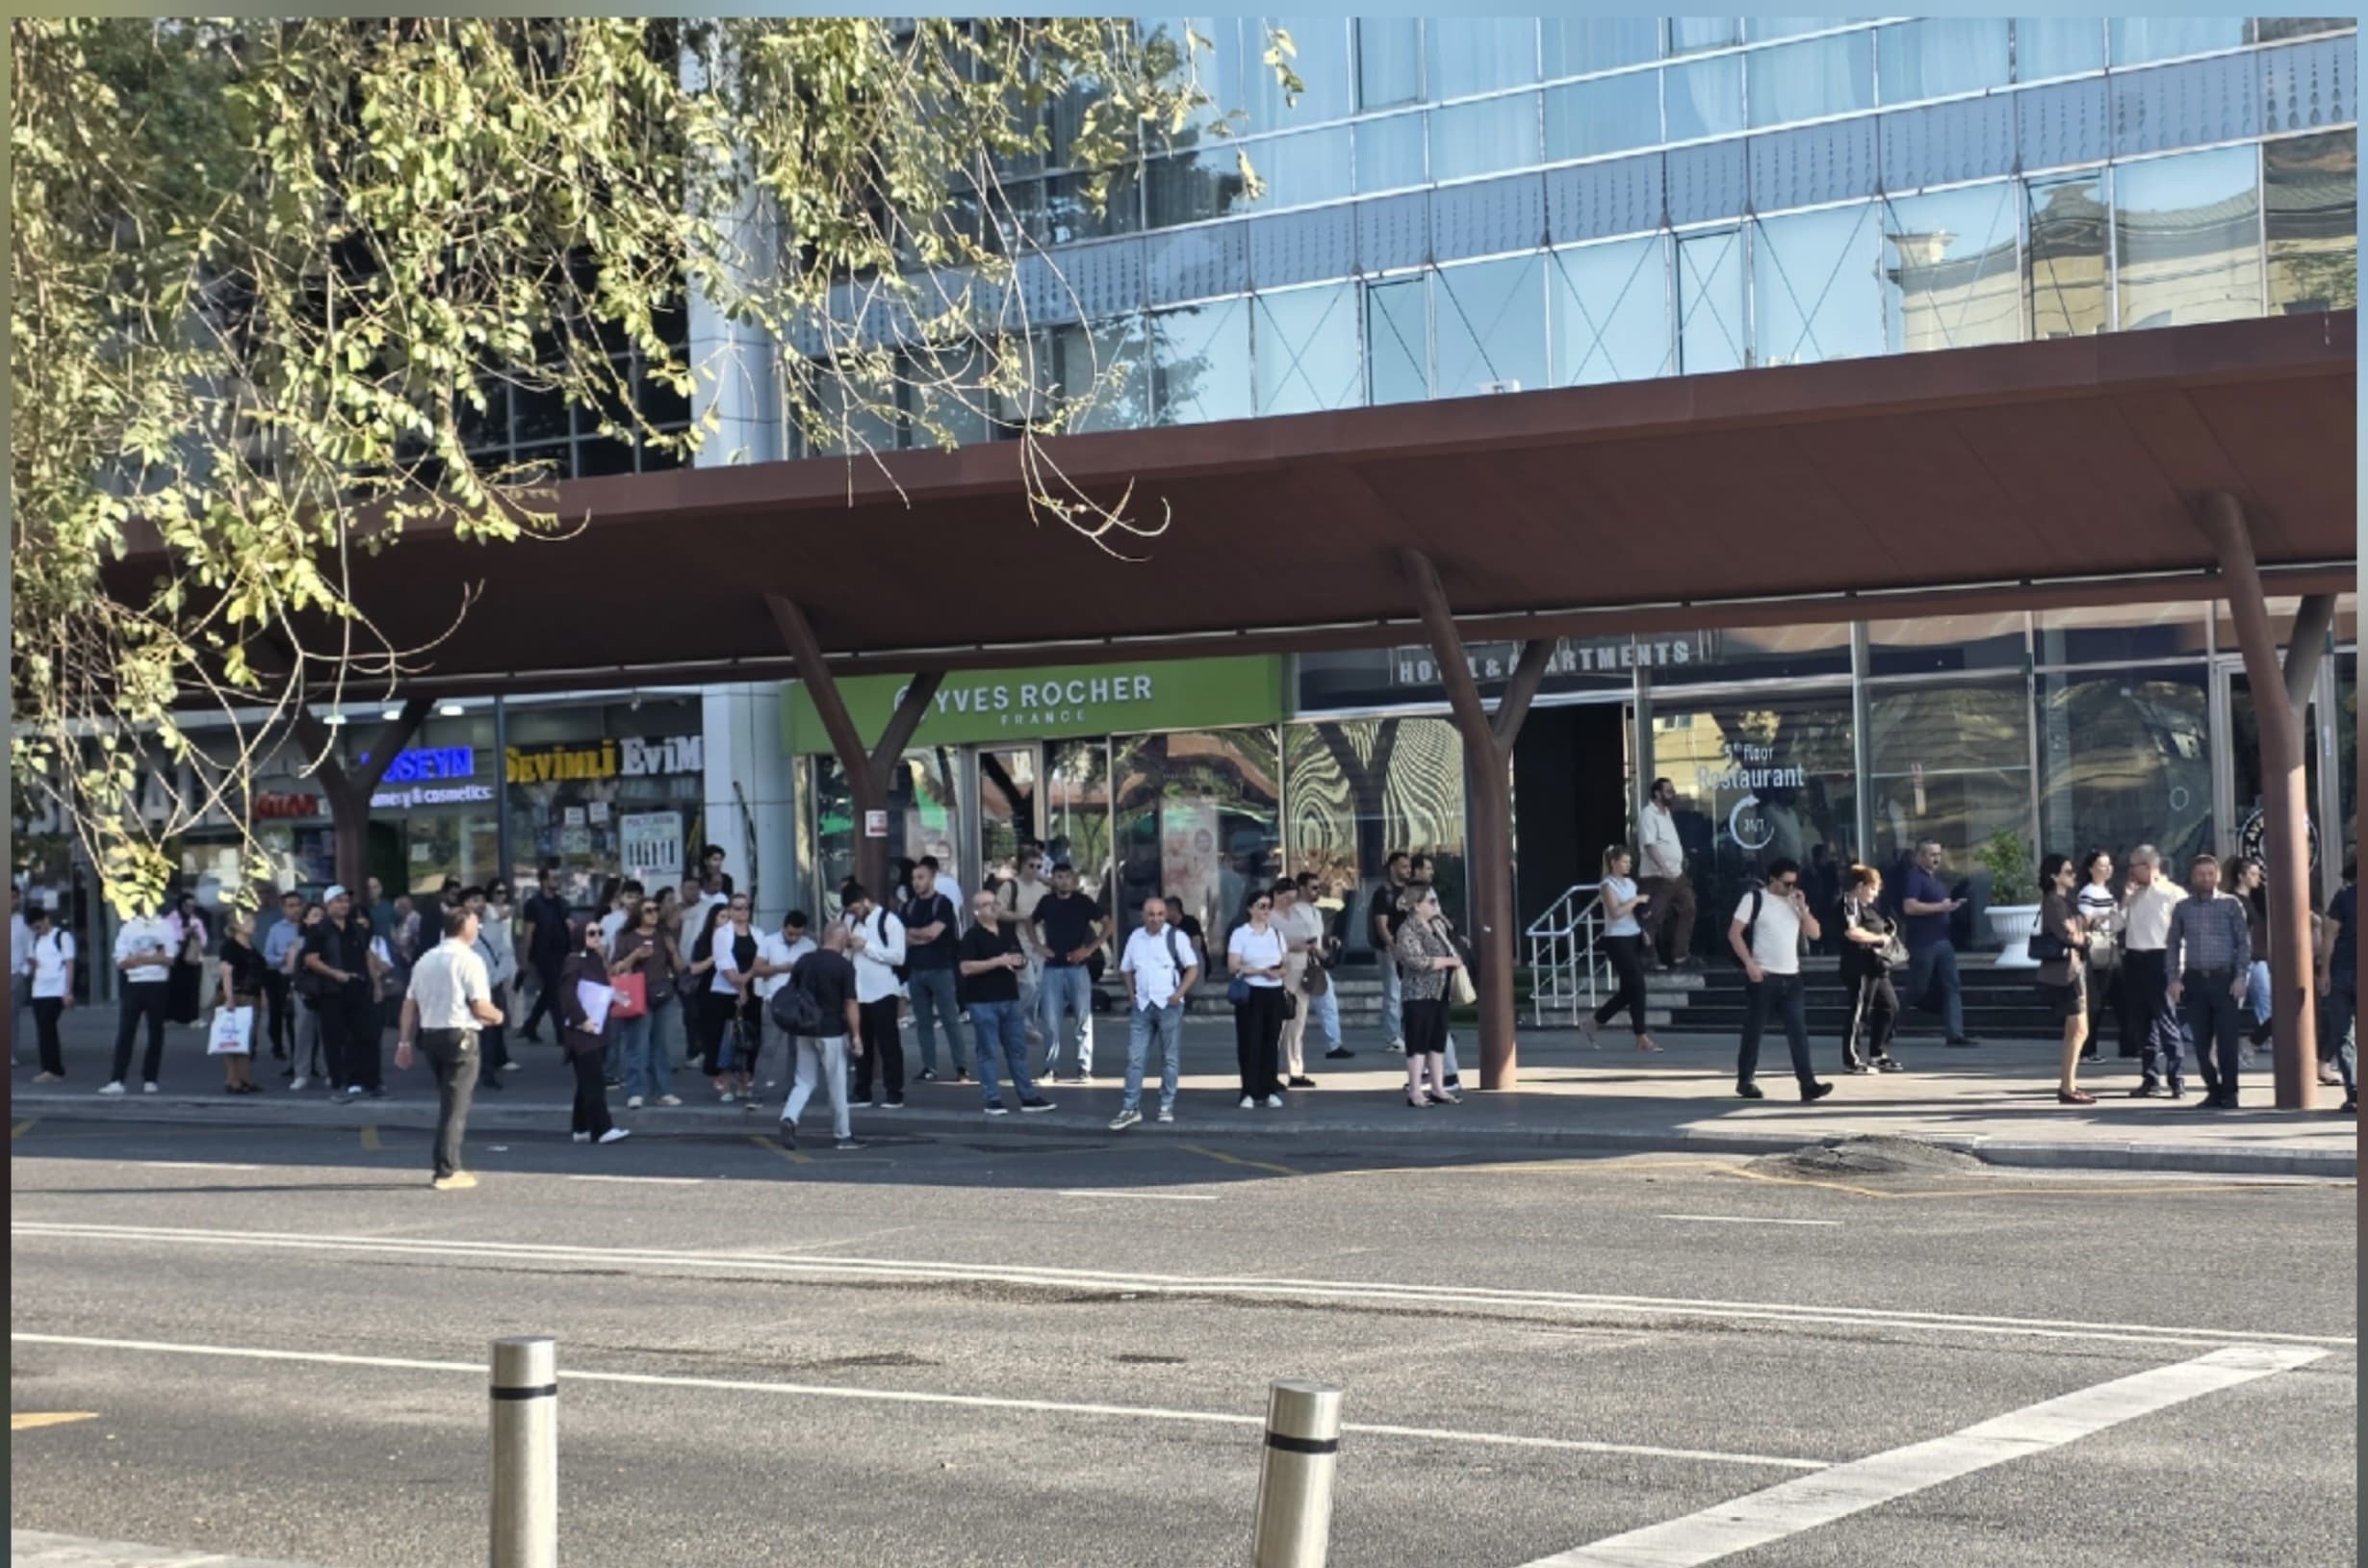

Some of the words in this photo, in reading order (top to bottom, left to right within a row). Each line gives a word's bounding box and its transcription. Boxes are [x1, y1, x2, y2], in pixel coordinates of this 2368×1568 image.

[1400, 656, 1480, 683] HOL
[1485, 657, 1502, 678] &
[1508, 640, 1689, 677] AARTMENTS
[935, 685, 1009, 713] YVES
[1020, 675, 1152, 707] ROCHER
[1001, 709, 1085, 726] FRANCE
[1698, 763, 1805, 788] Restaurant
[425, 784, 494, 804] cosmetics
